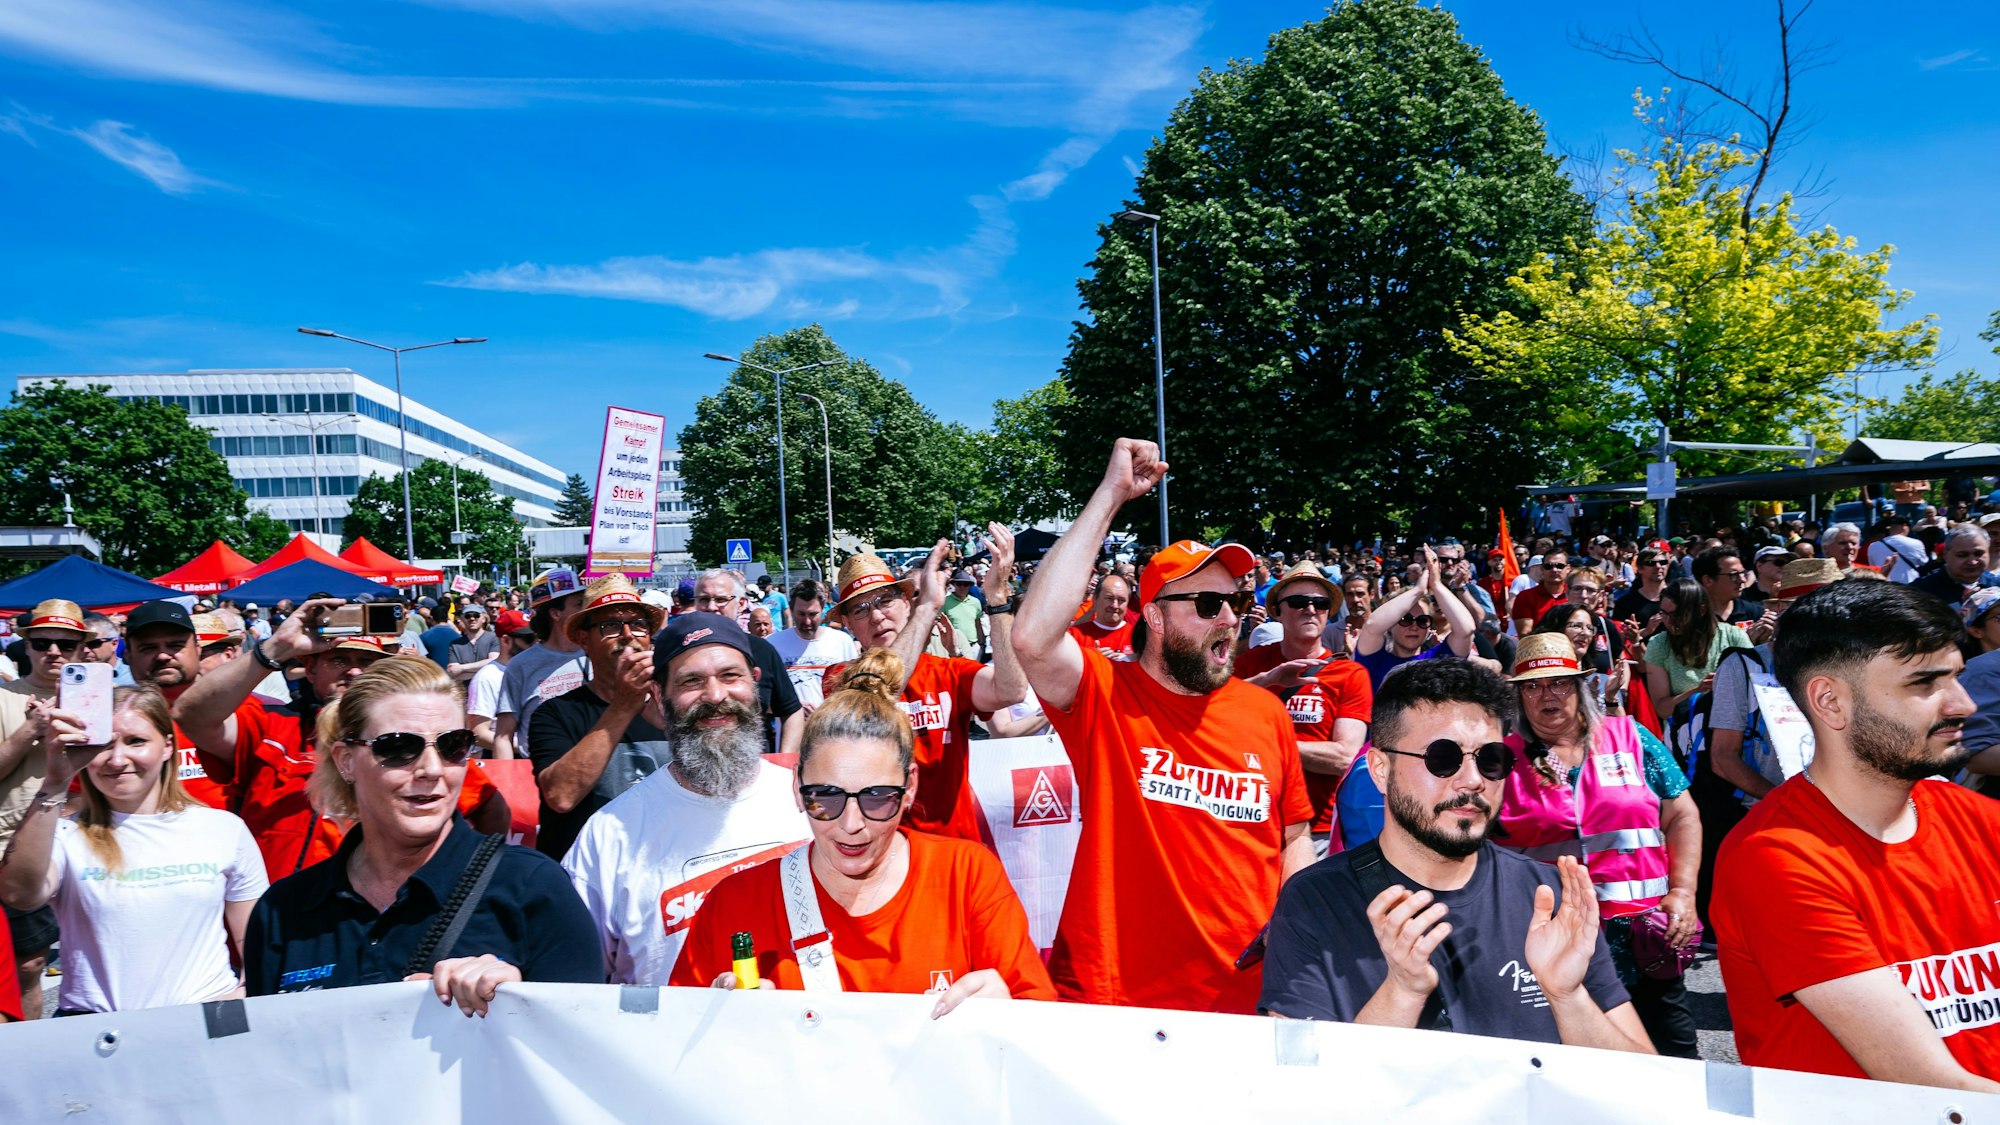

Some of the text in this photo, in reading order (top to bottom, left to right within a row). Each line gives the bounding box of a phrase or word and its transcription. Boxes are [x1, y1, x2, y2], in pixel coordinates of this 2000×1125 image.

[613, 416, 658, 433] Gemeinsamer
[624, 435, 647, 447] Kampf
[629, 453, 648, 464] jeden
[608, 467, 651, 481] Arbeitsplatz
[612, 486, 644, 500] Streik
[604, 506, 653, 519] bis Vorstands
[599, 520, 615, 529] Plan
[632, 522, 649, 531] Tisch
[184, 583, 217, 592] Metall
[852, 575, 886, 589] IG METALL
[602, 593, 637, 603] IG METALL
[1537, 658, 1564, 667] METALL
[1148, 780, 1192, 800] STATT
